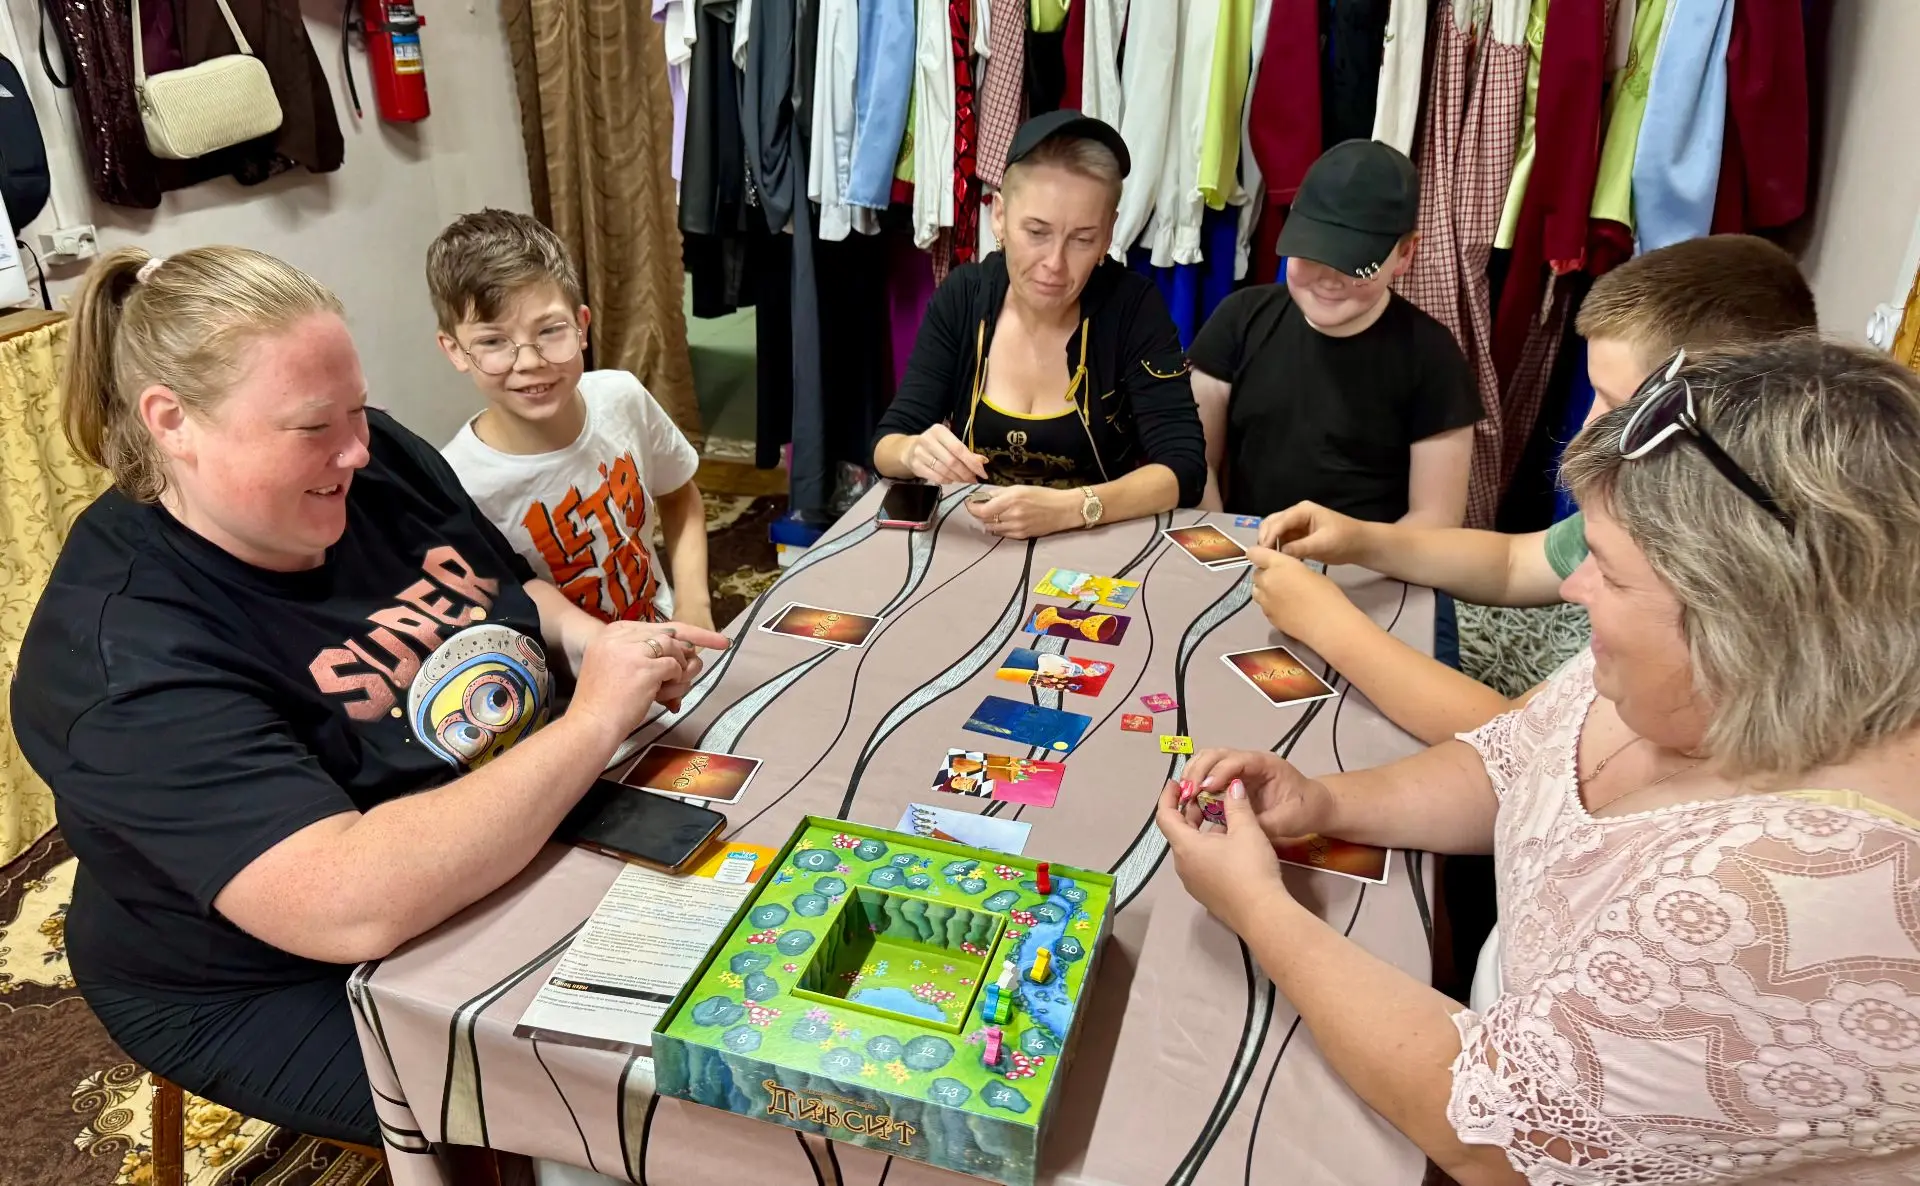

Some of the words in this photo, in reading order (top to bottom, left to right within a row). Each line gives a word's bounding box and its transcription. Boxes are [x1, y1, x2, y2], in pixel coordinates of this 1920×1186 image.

[308, 545, 500, 722] SUPER
[863, 846, 878, 854] 30
[808, 854, 824, 865] 0
[881, 872, 895, 881] 28
[825, 882, 835, 890] 1
[1065, 889, 1080, 899] 22
[806, 901, 816, 909] 2
[993, 896, 1008, 906] 24
[763, 911, 774, 920] 3
[790, 937, 801, 946] 4
[1060, 943, 1078, 954] 20
[756, 983, 768, 992] 6
[715, 1006, 728, 1016] 7
[807, 1025, 817, 1036] 9
[737, 1034, 748, 1044] 8
[1027, 1039, 1046, 1049] 16
[873, 1042, 891, 1053] 11
[917, 1046, 936, 1058] 12
[831, 1055, 851, 1067] 10
[938, 1086, 959, 1098] 13
[992, 1090, 1012, 1101] 14
